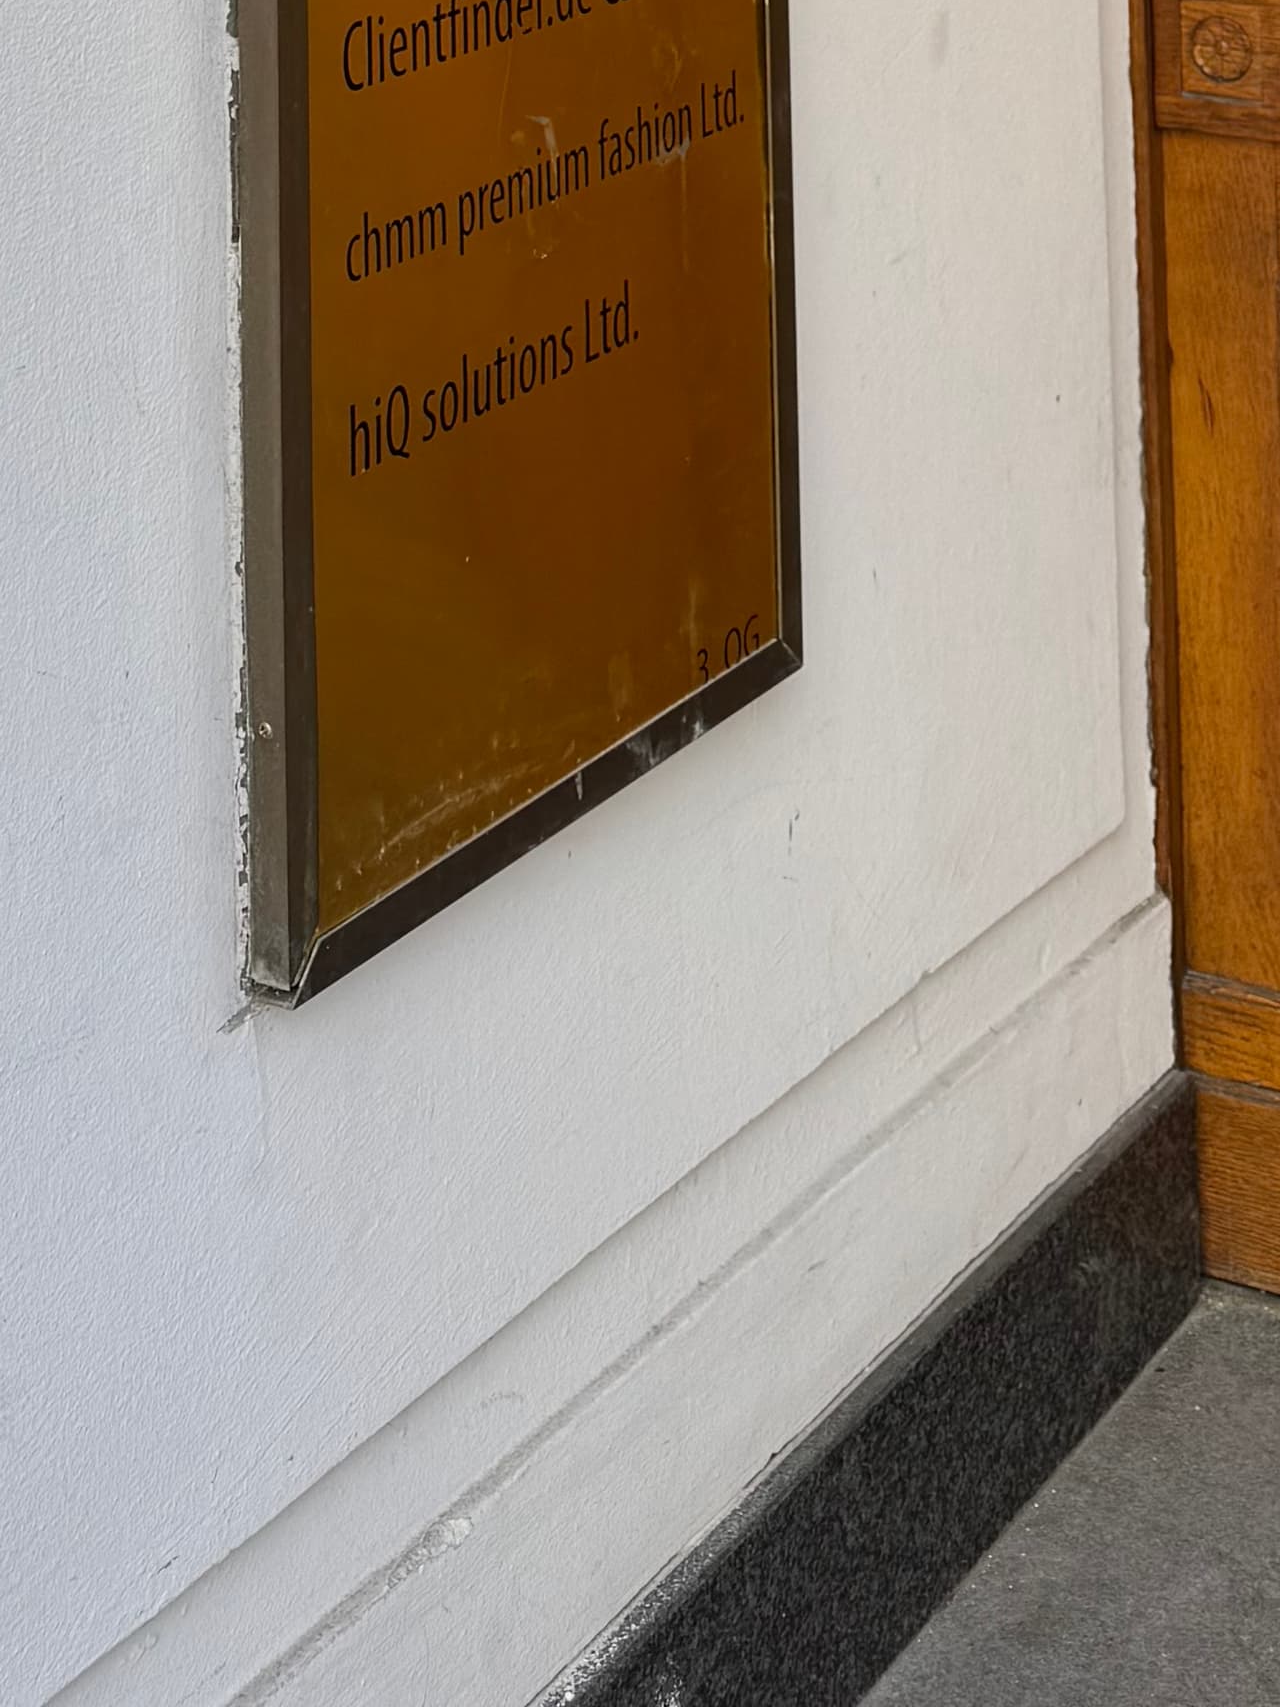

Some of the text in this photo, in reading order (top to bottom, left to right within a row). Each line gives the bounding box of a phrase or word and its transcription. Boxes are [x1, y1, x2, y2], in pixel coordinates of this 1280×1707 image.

[345, 69, 746, 282] chmm premium fashion Ltd.
[349, 279, 640, 477] hiQ solutions Ltd.
